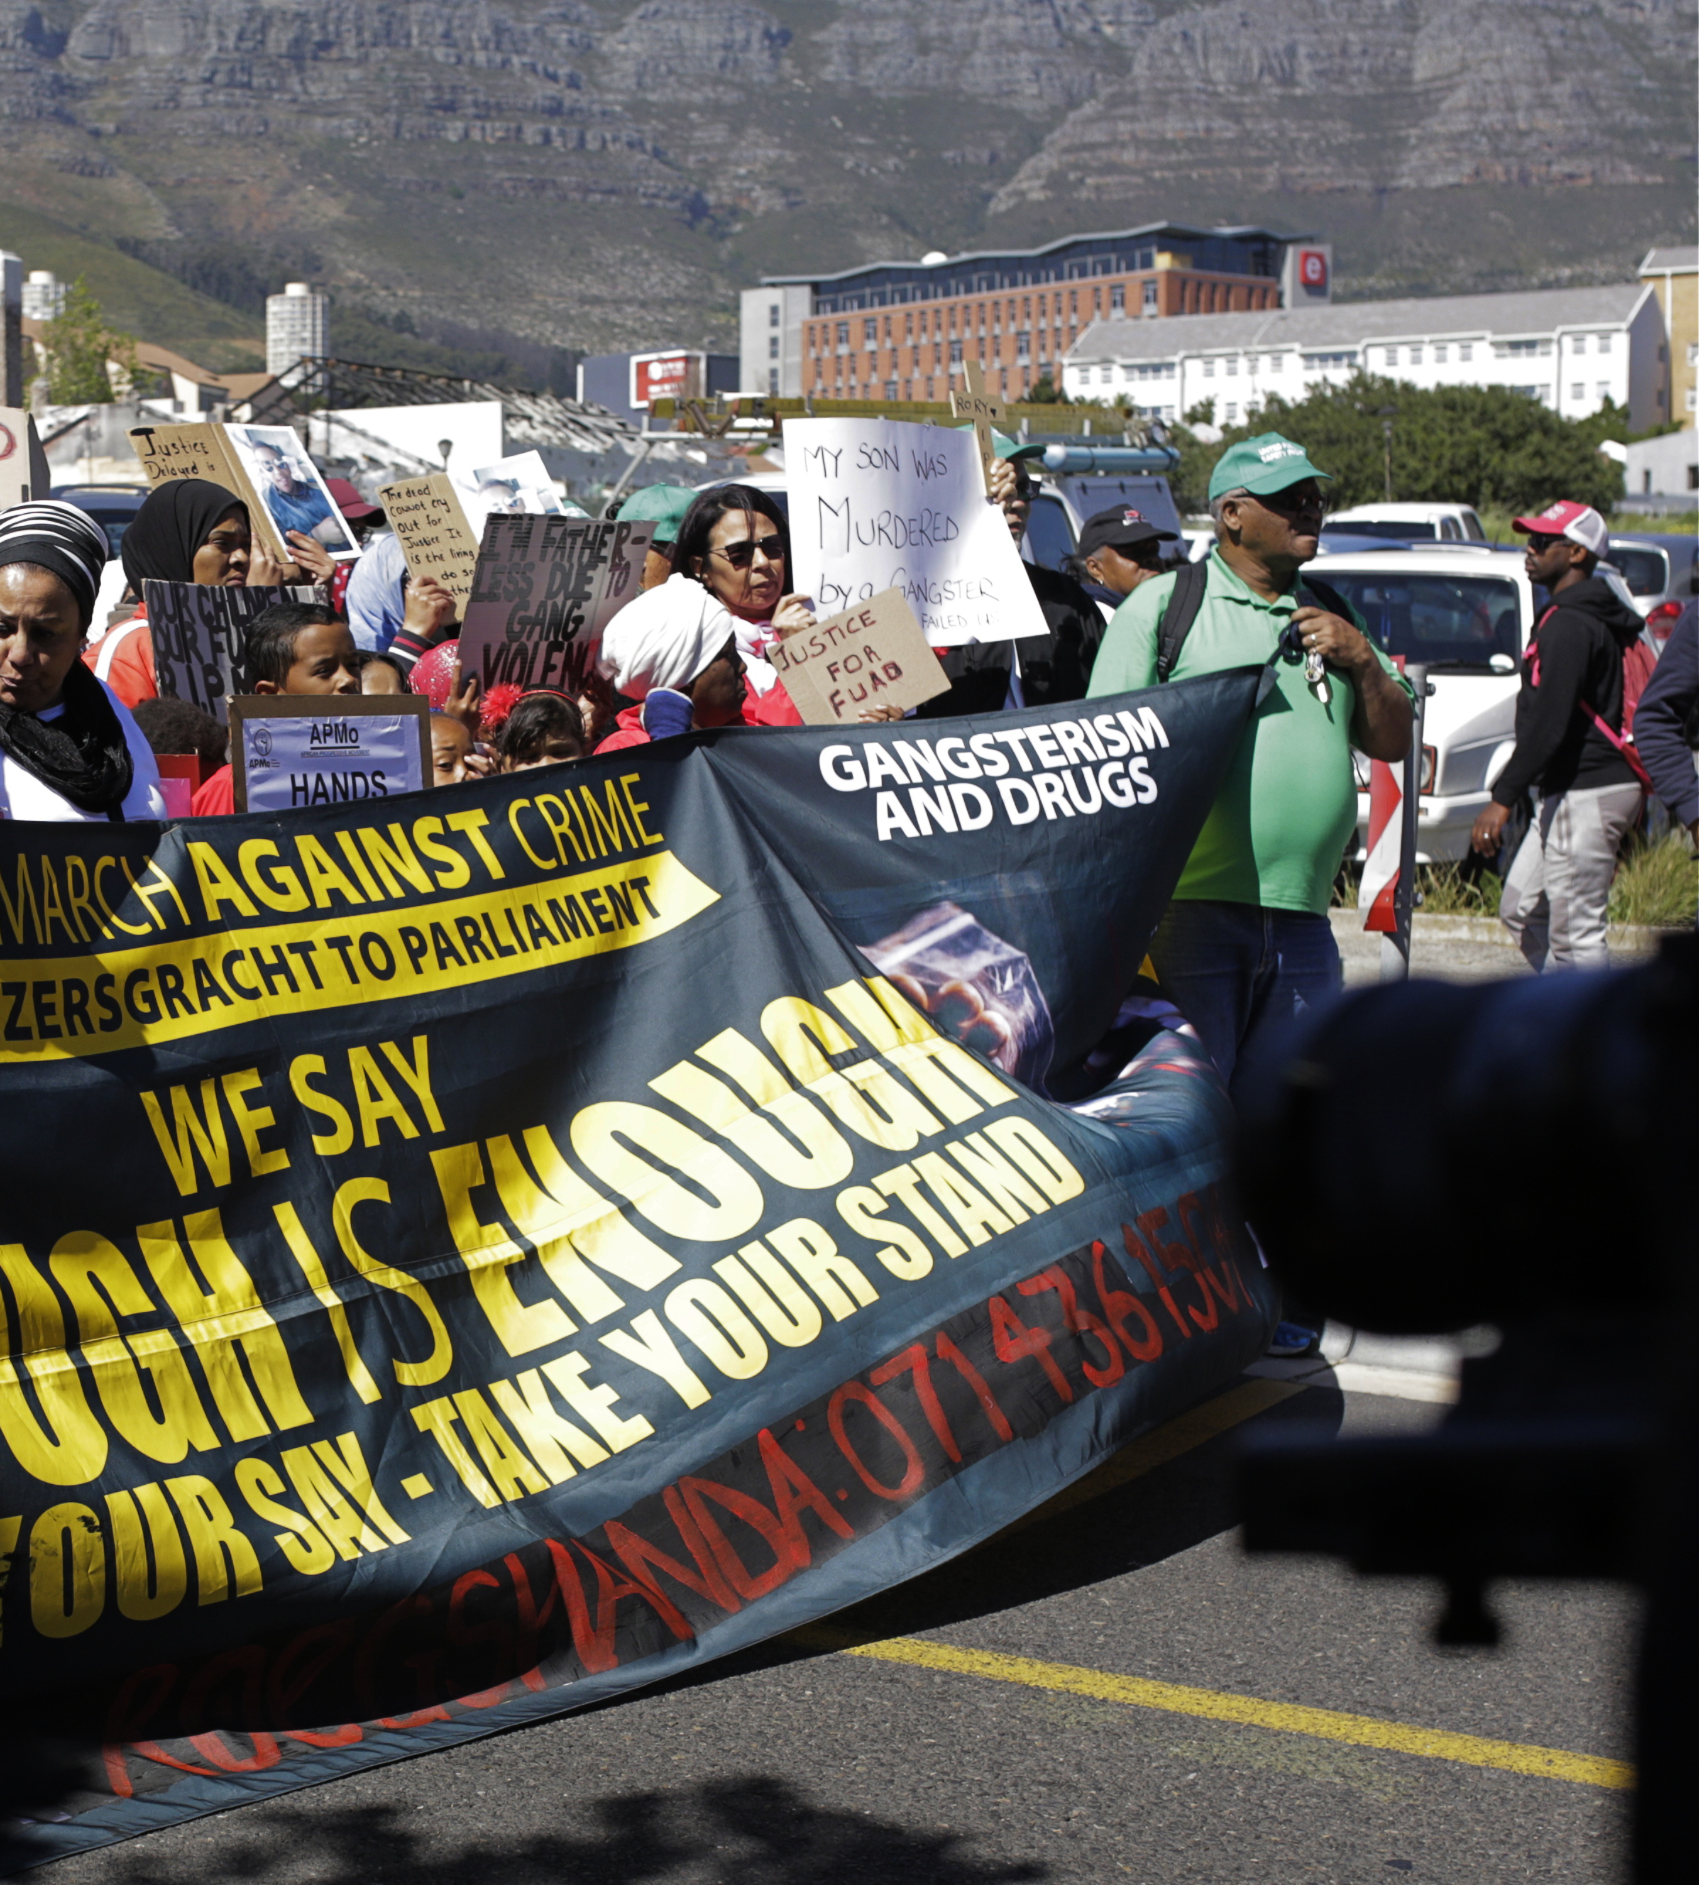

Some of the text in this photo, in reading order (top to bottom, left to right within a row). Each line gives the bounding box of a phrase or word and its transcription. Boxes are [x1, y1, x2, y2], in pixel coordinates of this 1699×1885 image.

[804, 443, 947, 480] MY SON WAS
[427, 514, 442, 527] for
[818, 496, 960, 553] MURDERED
[410, 554, 421, 564] is
[441, 569, 459, 580] do
[470, 561, 631, 602] LESS DUE TO
[819, 573, 853, 610] by
[890, 567, 1000, 606] GANGSTER
[145, 581, 197, 625] OUR
[506, 601, 585, 642] GANG
[922, 612, 968, 630] FAILED
[826, 644, 882, 683] FOR
[829, 661, 903, 717] FUAD
[310, 723, 359, 744] APMo
[818, 706, 1170, 792] GANGSTERISM
[249, 759, 270, 768] APMo
[290, 770, 388, 806] HANDS
[876, 756, 1158, 841] AND DRUGS
[186, 808, 506, 922] AGAINST
[508, 772, 664, 871] CRIME
[325, 931, 397, 985] TO
[398, 876, 662, 976] PARLIAMENT
[139, 1034, 447, 1197] WE SAY
[272, 1177, 454, 1406] IS
[428, 976, 1020, 1359] ENOUGH
[233, 1436, 412, 1576] SAY
[410, 1351, 657, 1510] TAKE
[599, 1217, 881, 1411] YOUR
[836, 1115, 1086, 1282] STAND
